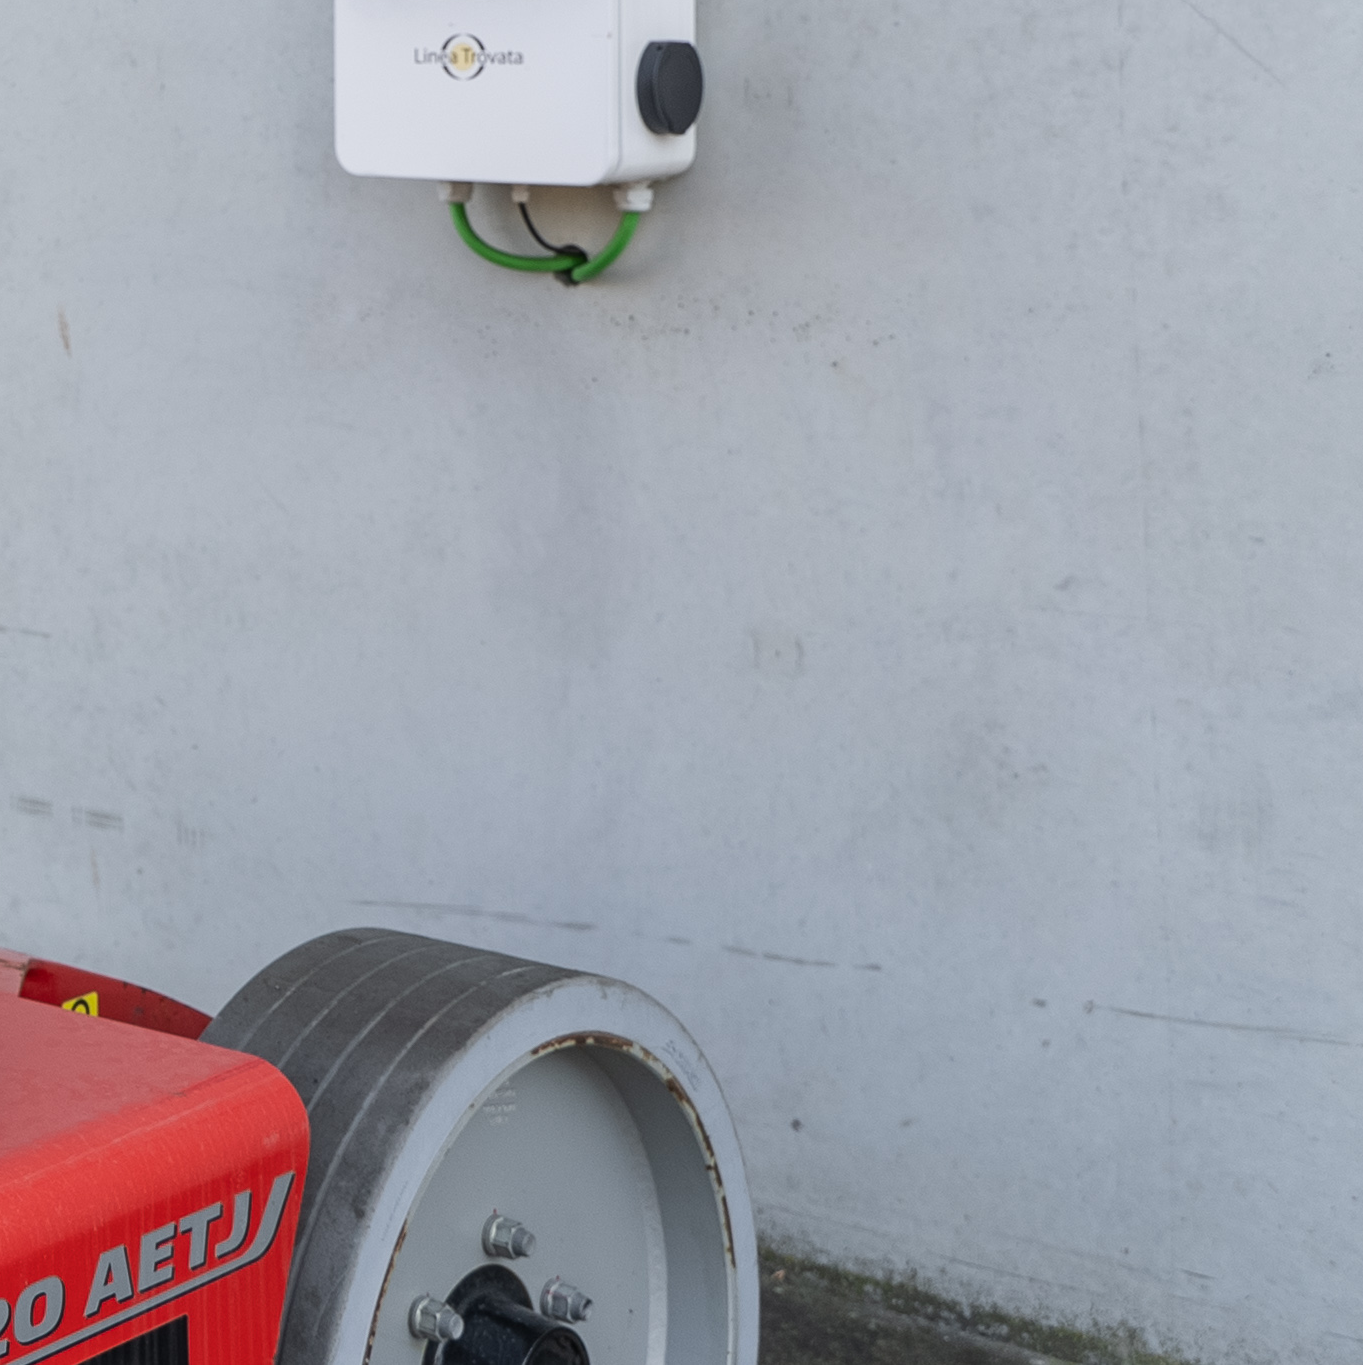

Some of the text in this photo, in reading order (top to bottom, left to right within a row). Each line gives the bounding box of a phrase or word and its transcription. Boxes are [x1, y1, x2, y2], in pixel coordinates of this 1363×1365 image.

[414, 47, 524, 65] Linea Trovata
[83, 1189, 253, 1318] AETJ
